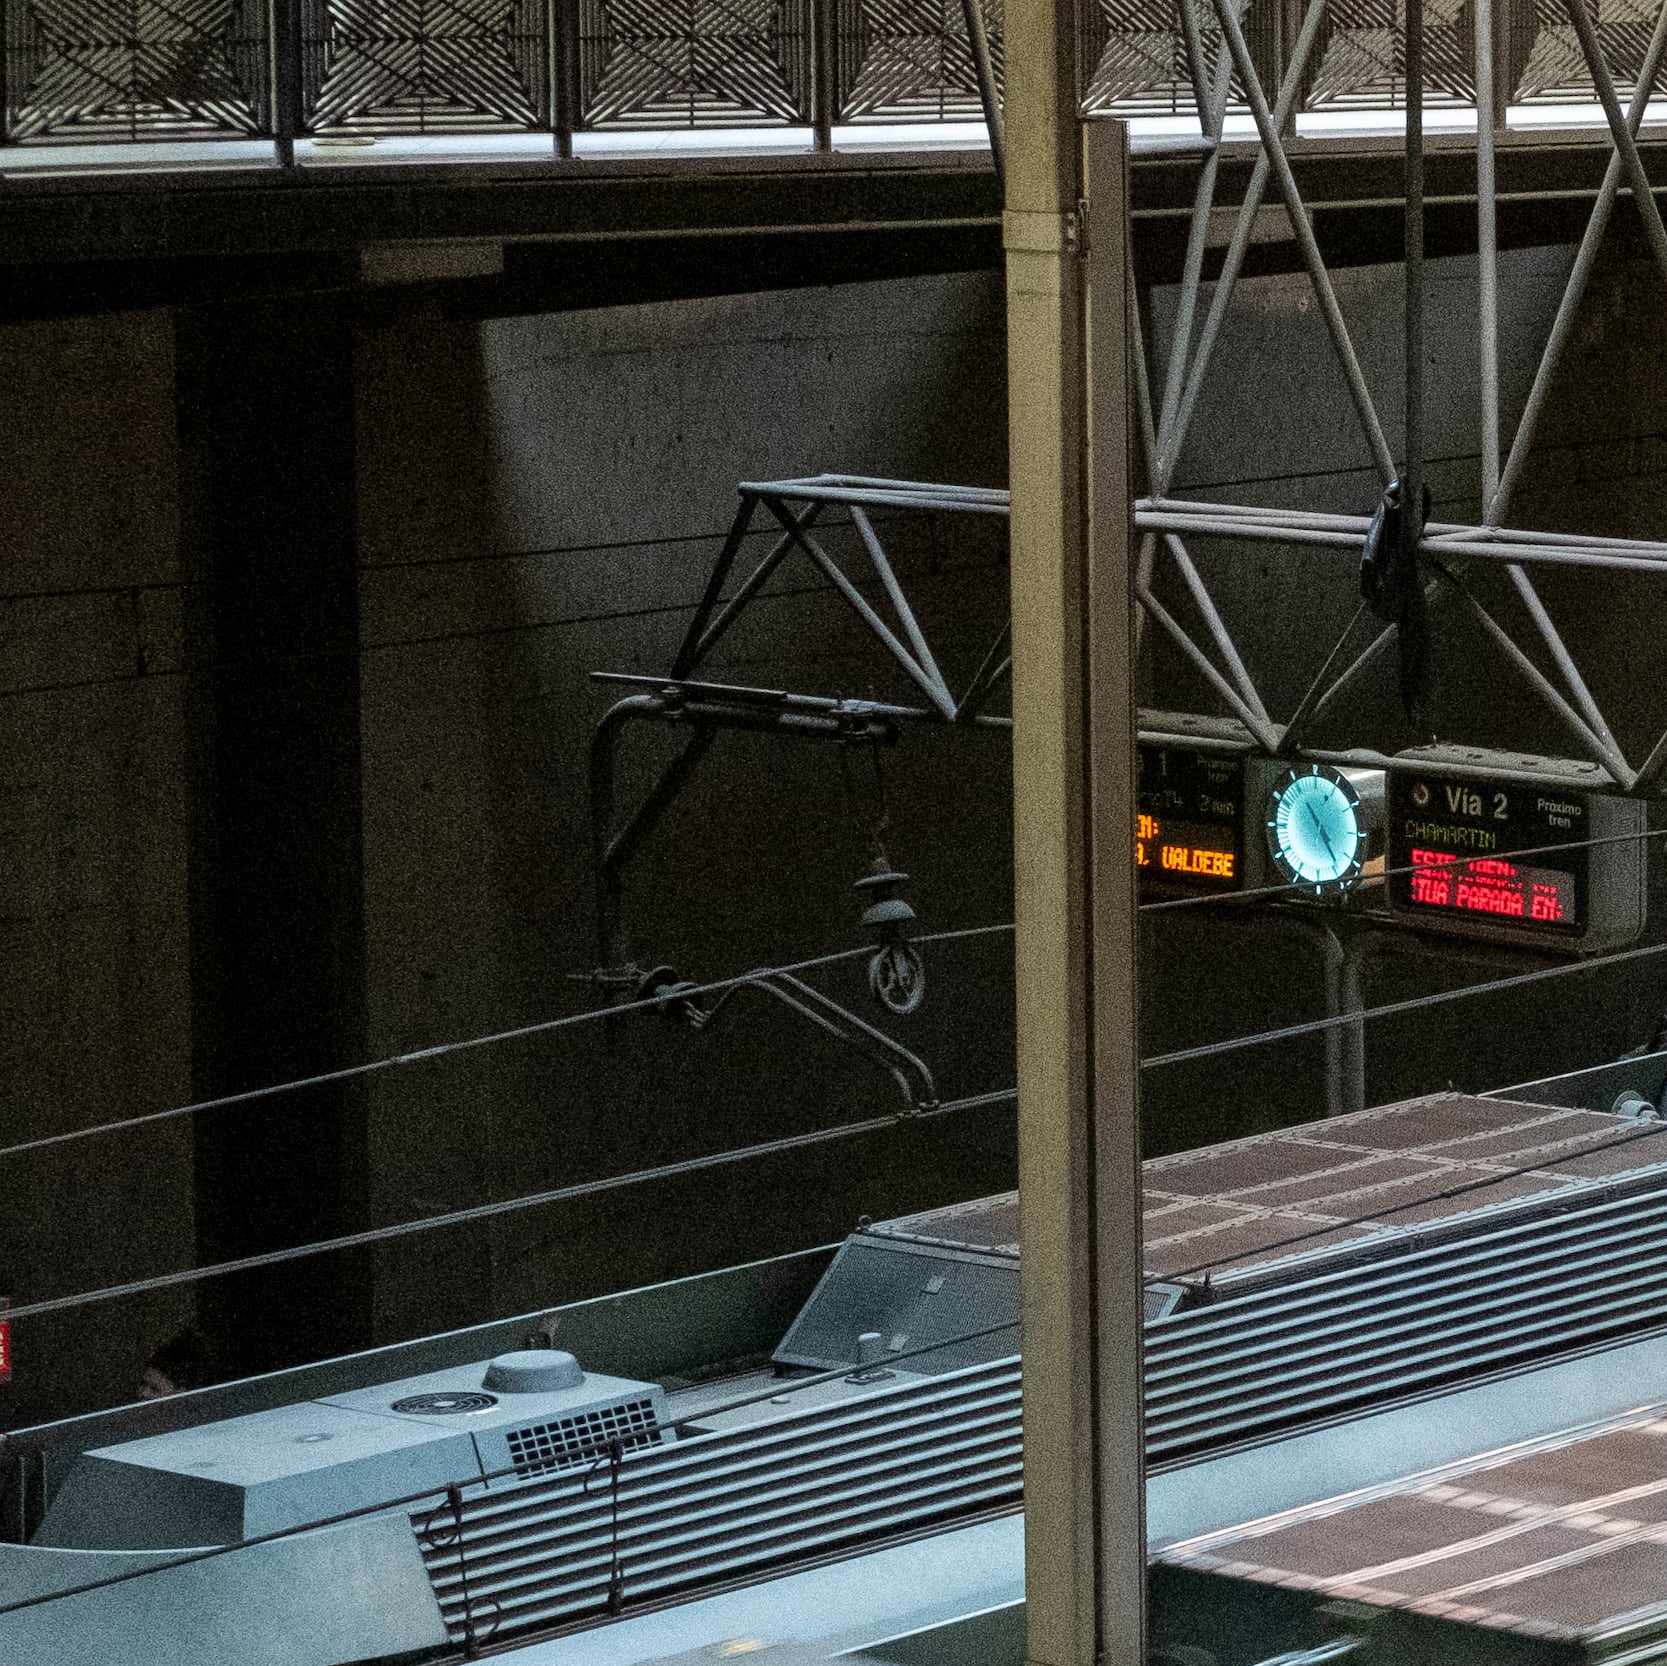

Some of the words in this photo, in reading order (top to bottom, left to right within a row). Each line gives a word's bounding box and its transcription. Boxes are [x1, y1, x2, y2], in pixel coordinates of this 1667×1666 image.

[1446, 785, 1482, 817] Vía
[1493, 793, 1509, 820] 2
[1536, 798, 1582, 817] Próximo
[1404, 819, 1497, 850] CHAMARTIN
[1548, 813, 1572, 829] tren
[1455, 884, 1524, 917] PARADA
